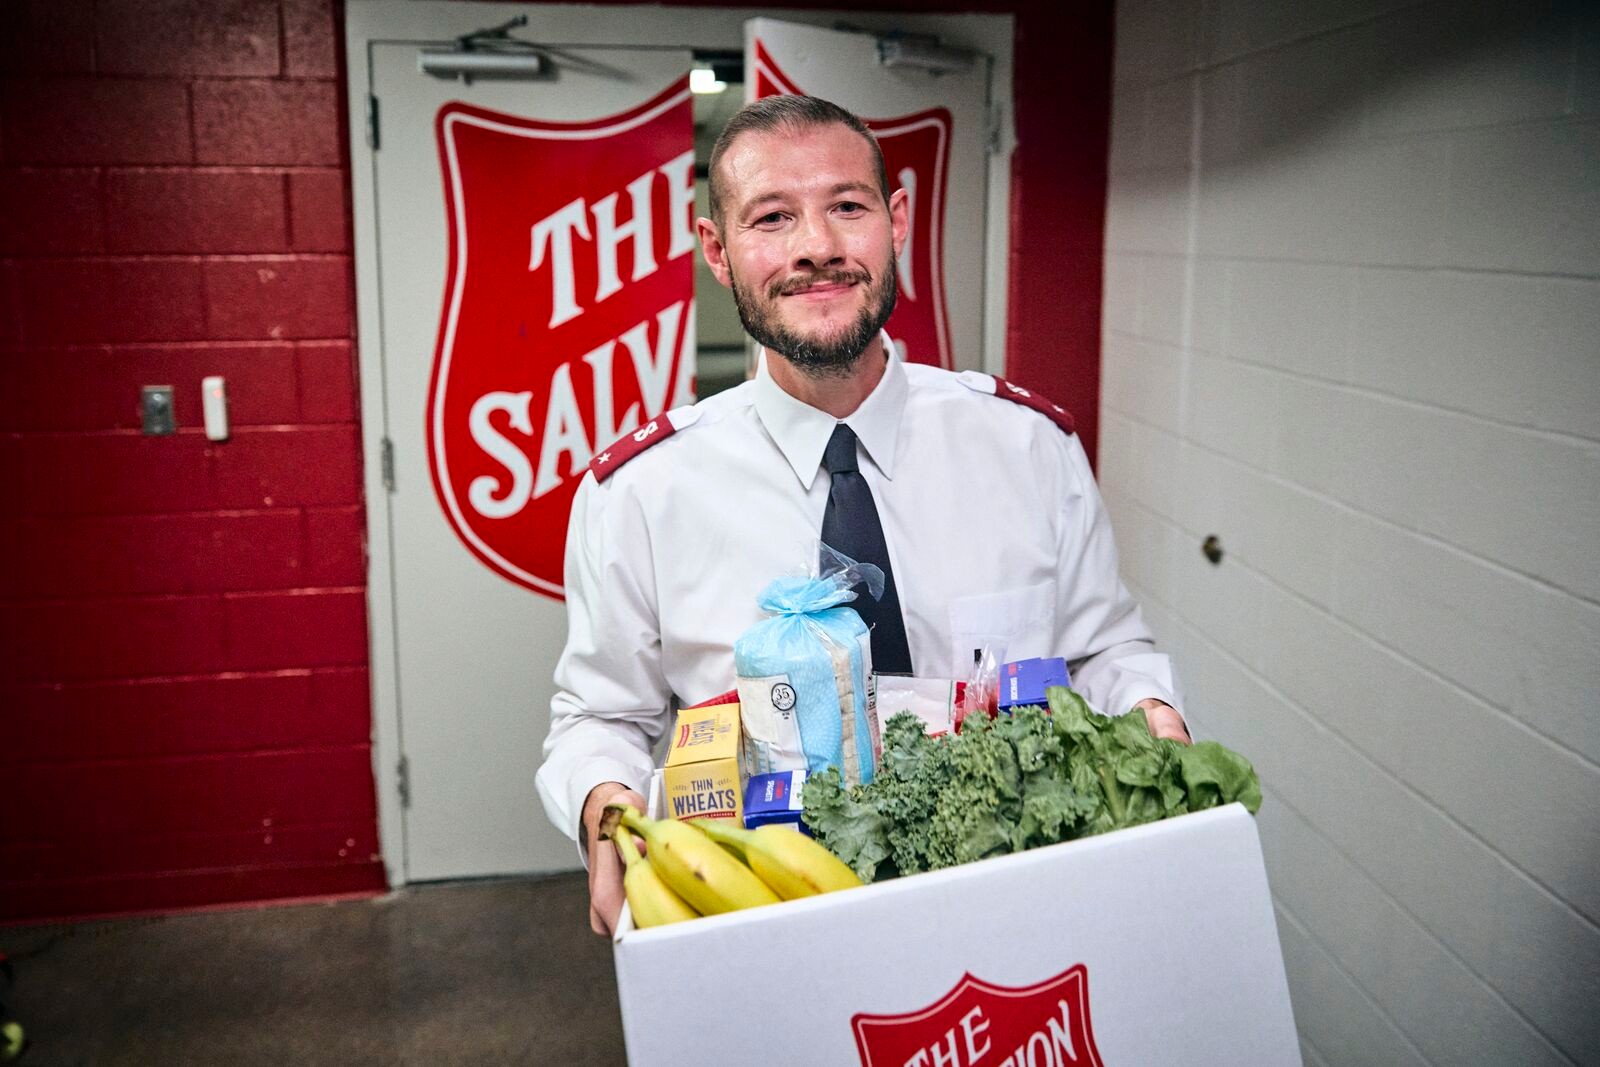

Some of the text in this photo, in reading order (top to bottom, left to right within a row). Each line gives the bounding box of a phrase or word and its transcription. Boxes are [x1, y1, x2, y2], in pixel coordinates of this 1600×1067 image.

[775, 687, 790, 700] 35
[691, 778, 713, 792] THIN
[673, 788, 736, 817] WHEATS
[999, 998, 1078, 1067] ON
